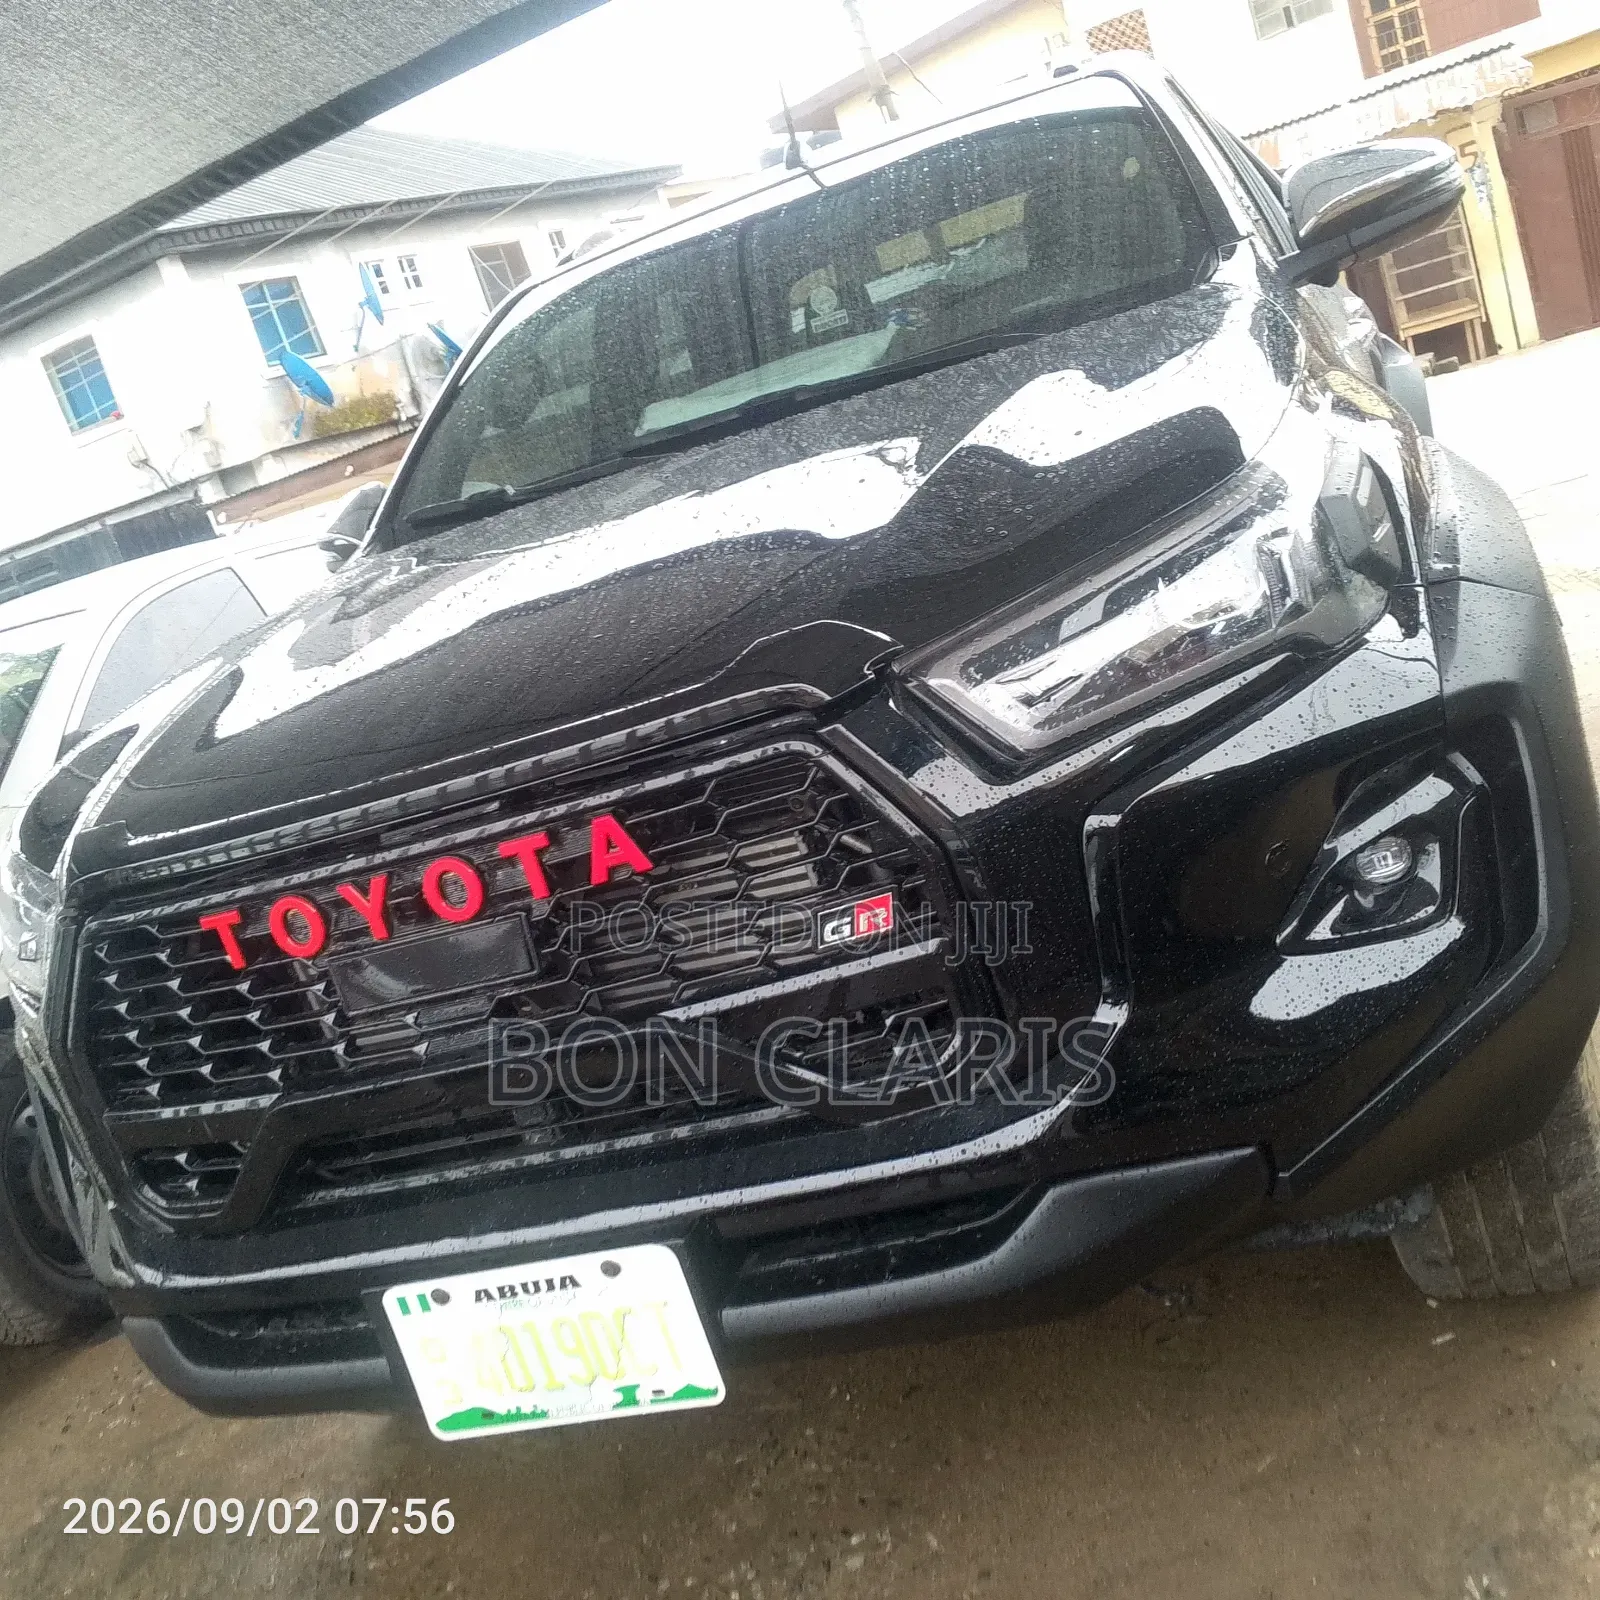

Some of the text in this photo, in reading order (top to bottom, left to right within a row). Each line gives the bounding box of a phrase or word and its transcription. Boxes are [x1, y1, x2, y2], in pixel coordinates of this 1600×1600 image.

[199, 813, 654, 970] TOYOTA
[821, 905, 890, 944] GR
[474, 1274, 582, 1303] ABUJA
